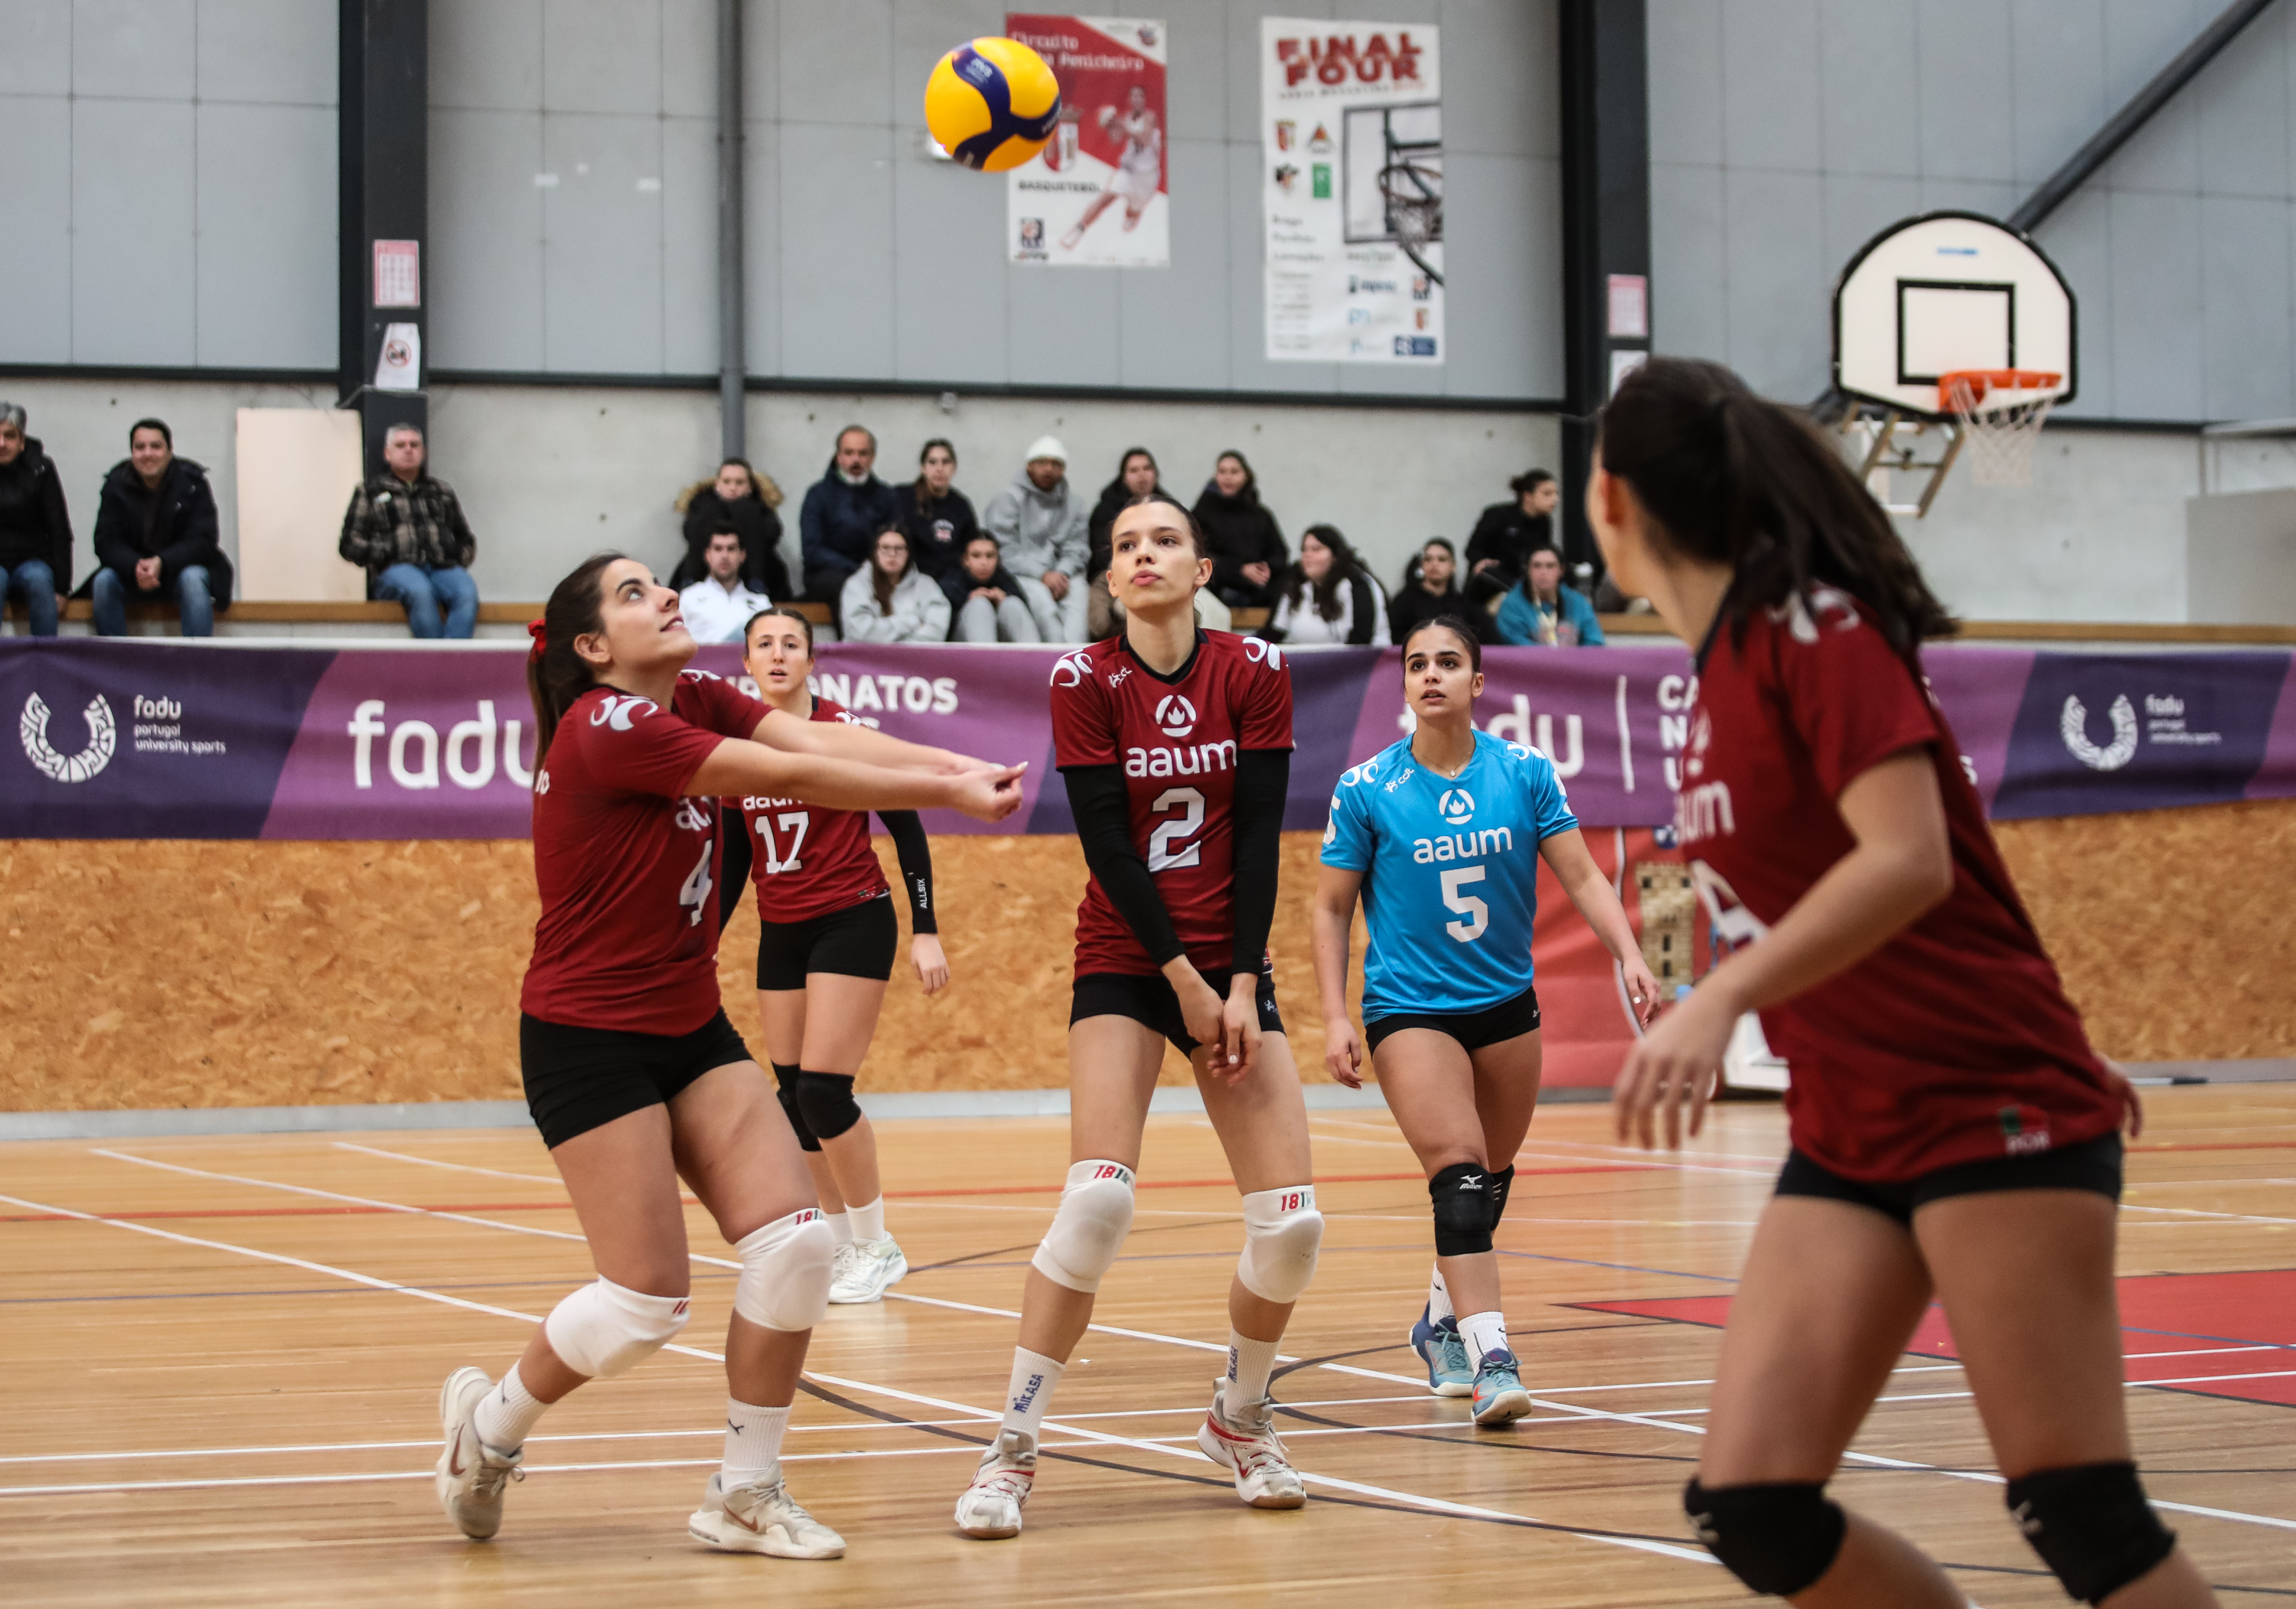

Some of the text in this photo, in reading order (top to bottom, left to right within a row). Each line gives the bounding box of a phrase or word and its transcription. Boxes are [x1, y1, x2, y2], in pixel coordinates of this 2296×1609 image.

[1277, 32, 1423, 62] FINAL
[1287, 57, 1419, 87] FOUR
[135, 694, 181, 720] fadu
[134, 723, 181, 739] portugal
[135, 737, 227, 756] university sports
[1125, 739, 1238, 778] aaum
[1397, 768, 1415, 785] cdt
[755, 811, 810, 874] 17
[1149, 786, 1206, 873] 2
[1413, 827, 1513, 864] aaum
[679, 838, 713, 927] 4
[917, 878, 928, 909] ALLSIX
[1440, 865, 1489, 943] 5
[1013, 1374, 1044, 1413] MIKASA
